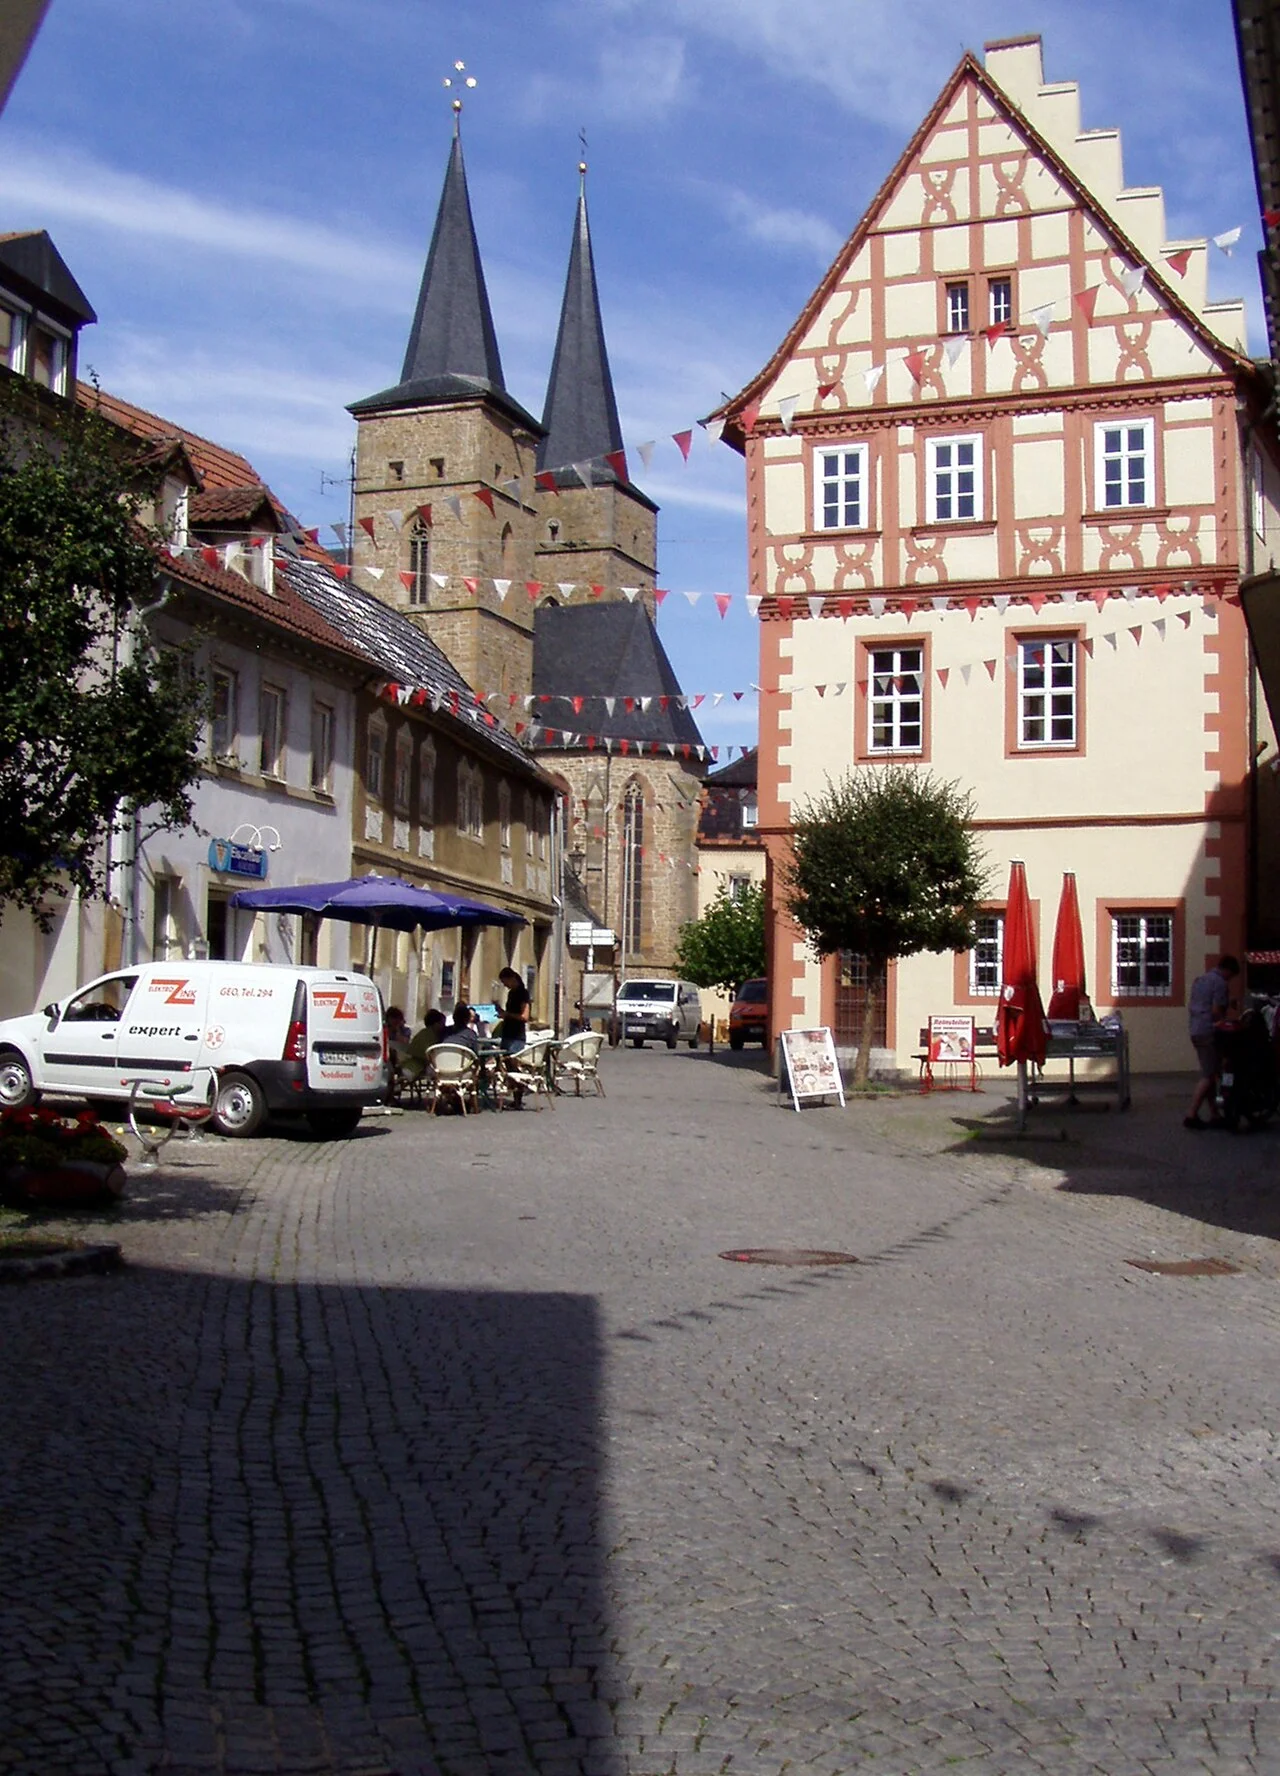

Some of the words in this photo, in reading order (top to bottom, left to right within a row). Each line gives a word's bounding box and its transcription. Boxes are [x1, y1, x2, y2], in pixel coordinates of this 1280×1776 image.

[241, 988, 255, 997] Tel.
[257, 988, 273, 998] 294
[128, 1025, 181, 1038] expert
[320, 1070, 354, 1080] Notdienst
